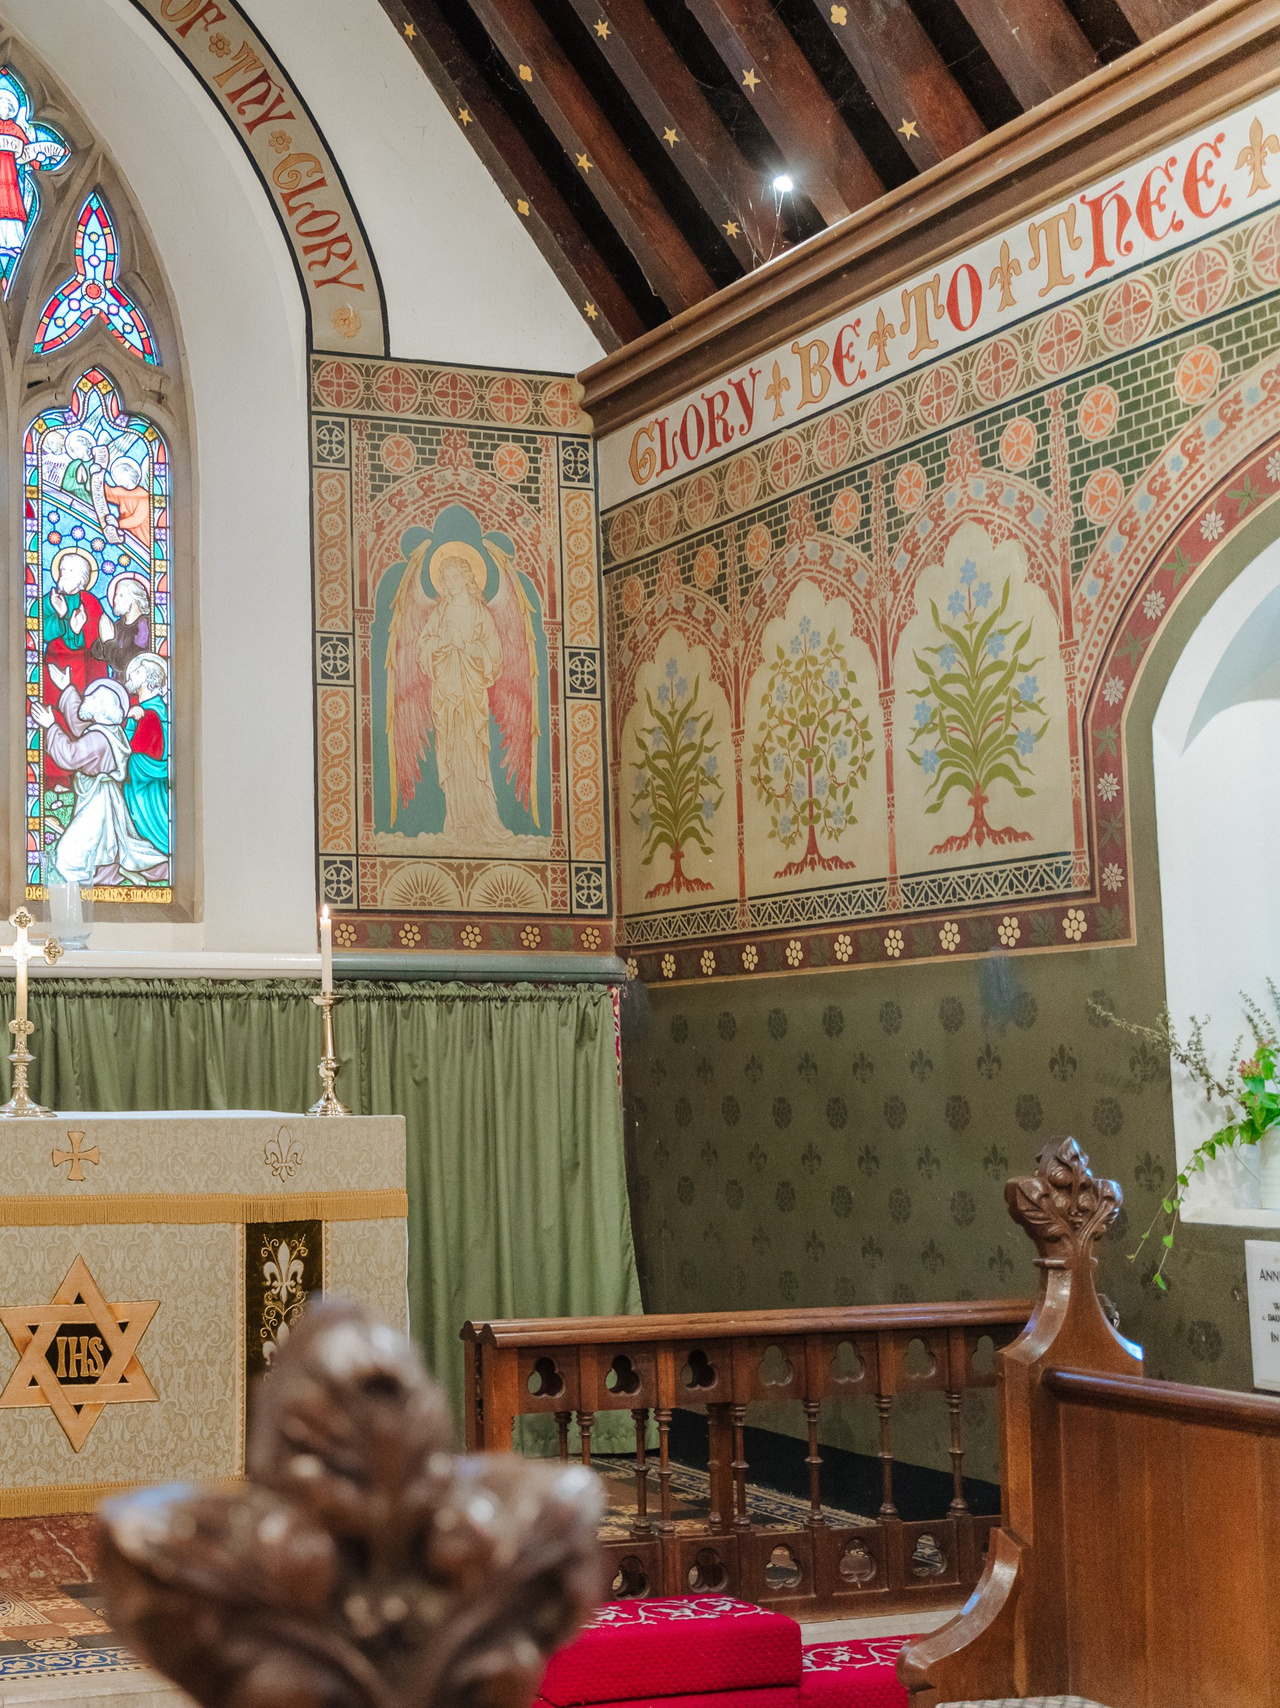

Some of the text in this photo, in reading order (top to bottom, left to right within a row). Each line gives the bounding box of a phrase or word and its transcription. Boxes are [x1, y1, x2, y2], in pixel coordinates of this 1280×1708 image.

[213, 40, 297, 136] THY
[271, 153, 365, 293] GLORY
[628, 132, 1232, 486] GLORY BE TO THEE
[56, 1335, 105, 1378] IHS
